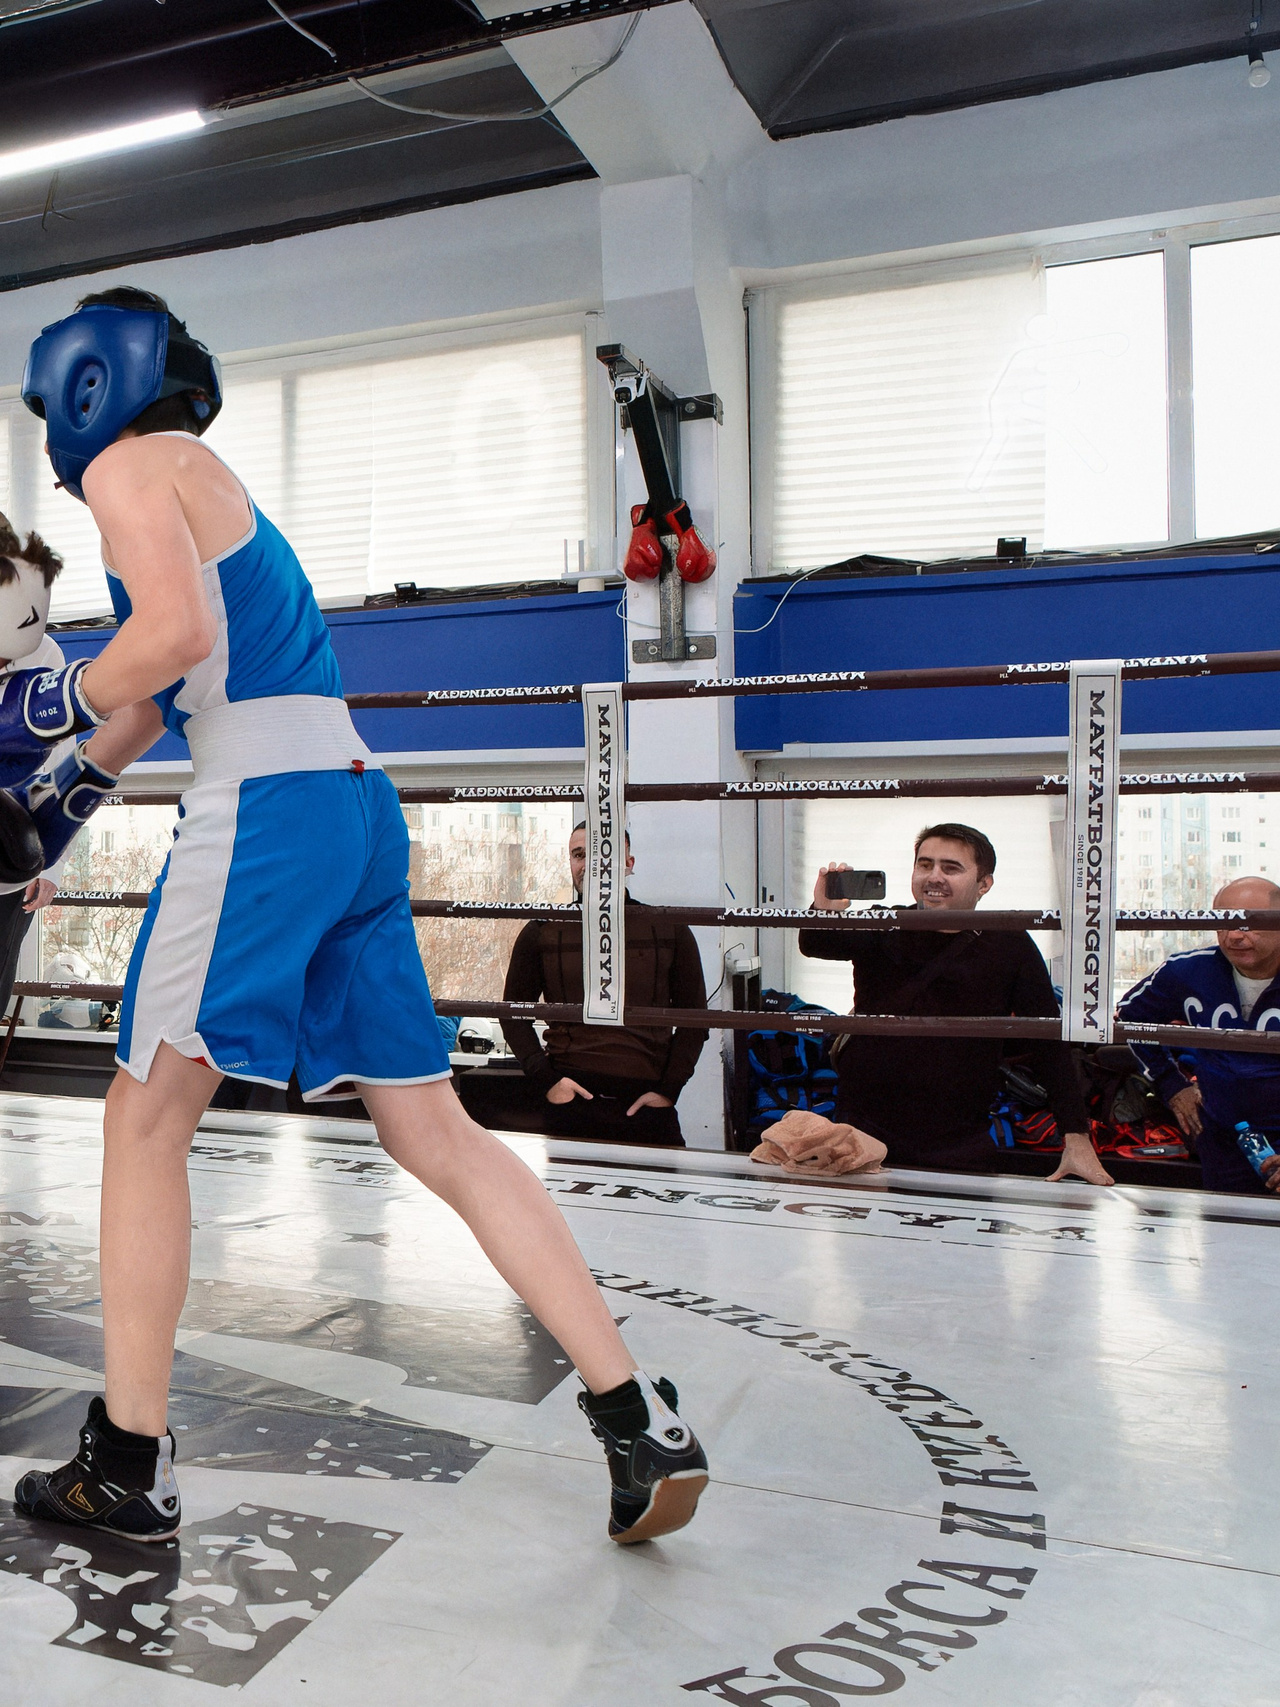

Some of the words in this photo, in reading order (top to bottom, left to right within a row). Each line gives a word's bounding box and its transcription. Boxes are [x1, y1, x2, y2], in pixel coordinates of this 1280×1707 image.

[695, 671, 866, 688] MAYFATBOXINGGYM
[426, 684, 575, 700] MAYFATBOXINGGYM
[39, 709, 48, 718] 10
[48, 707, 58, 716] OZ
[725, 779, 901, 793] MAYFATBOXINGGYM
[597, 703, 614, 1003] MAYFATBOXINGGYM
[1083, 689, 1106, 1030] MAYFATBOXINGGYM
[940, 1500, 1047, 1551] И
